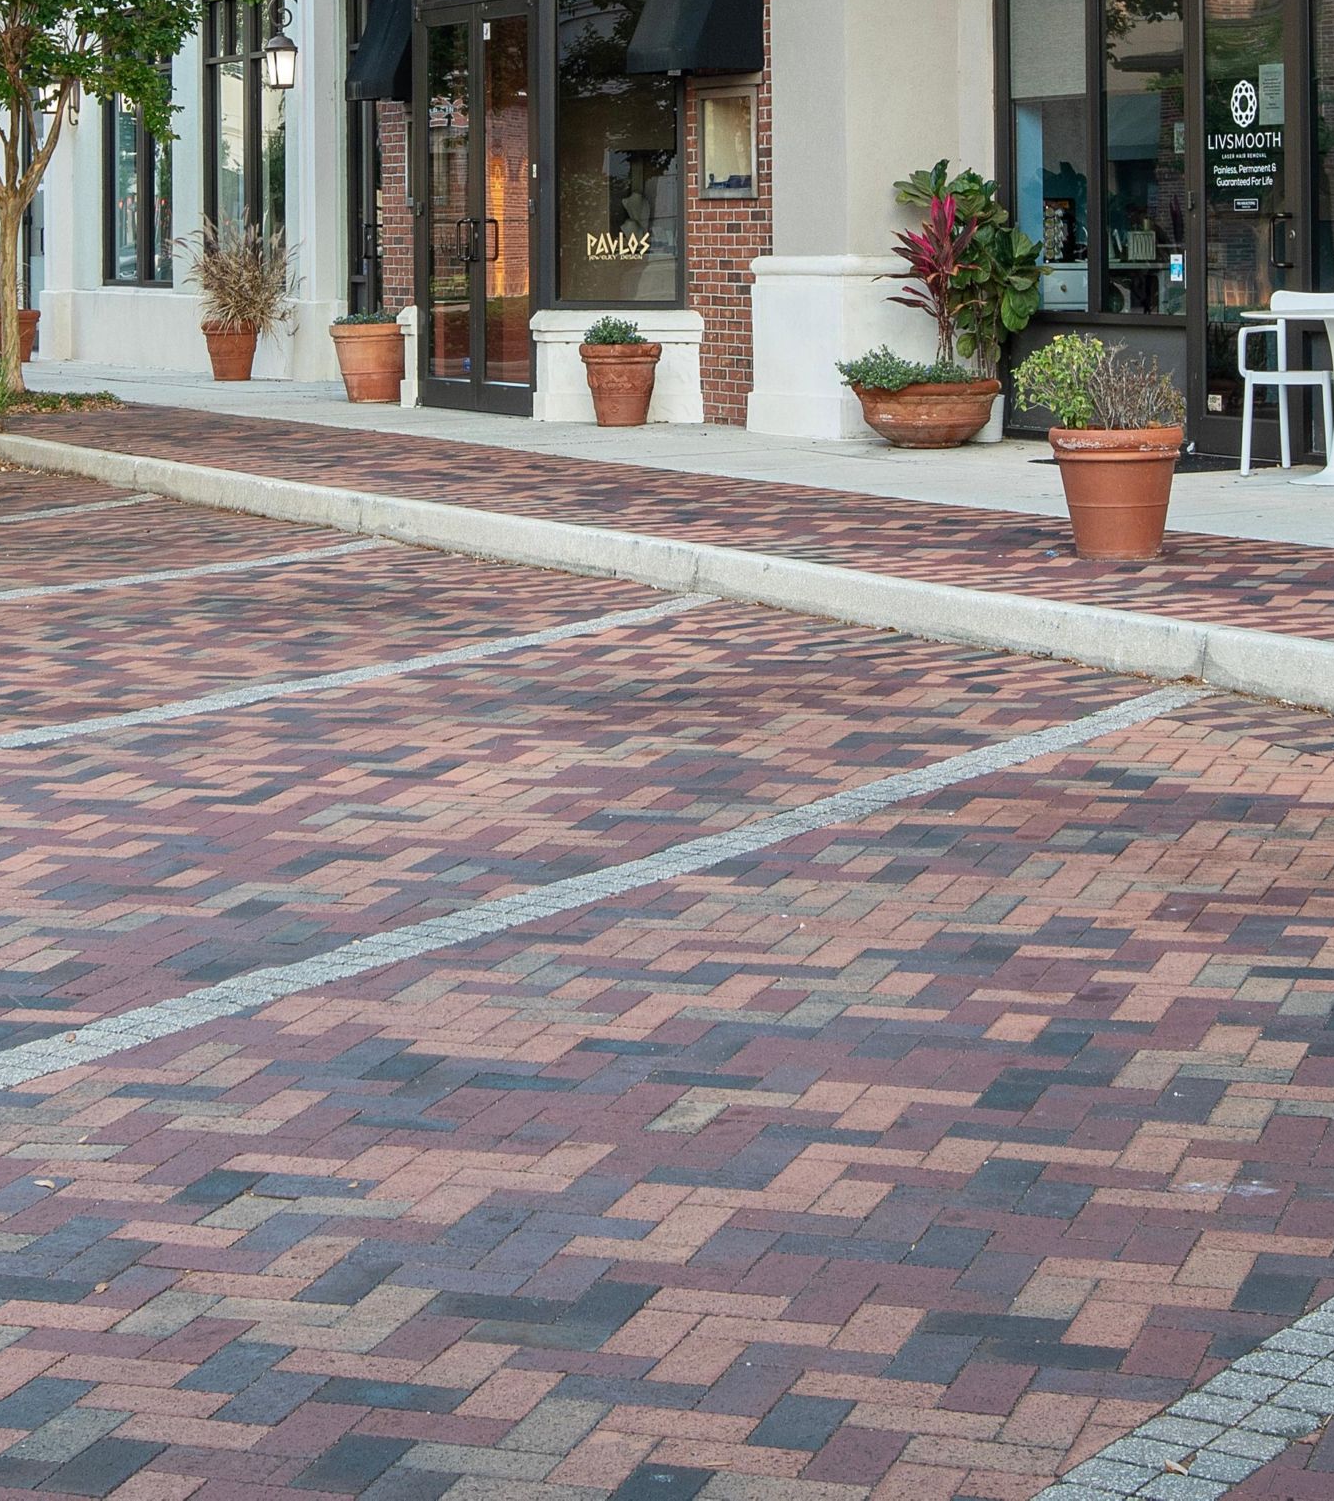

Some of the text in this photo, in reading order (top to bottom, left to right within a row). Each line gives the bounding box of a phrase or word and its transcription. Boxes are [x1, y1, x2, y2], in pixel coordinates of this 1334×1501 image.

[1207, 131, 1282, 150] LIVSMOOTH
[1213, 163, 1277, 175] Painless, Permanent &
[1216, 176, 1273, 187] Guaranteed For Life
[587, 232, 650, 255] PAVLOS
